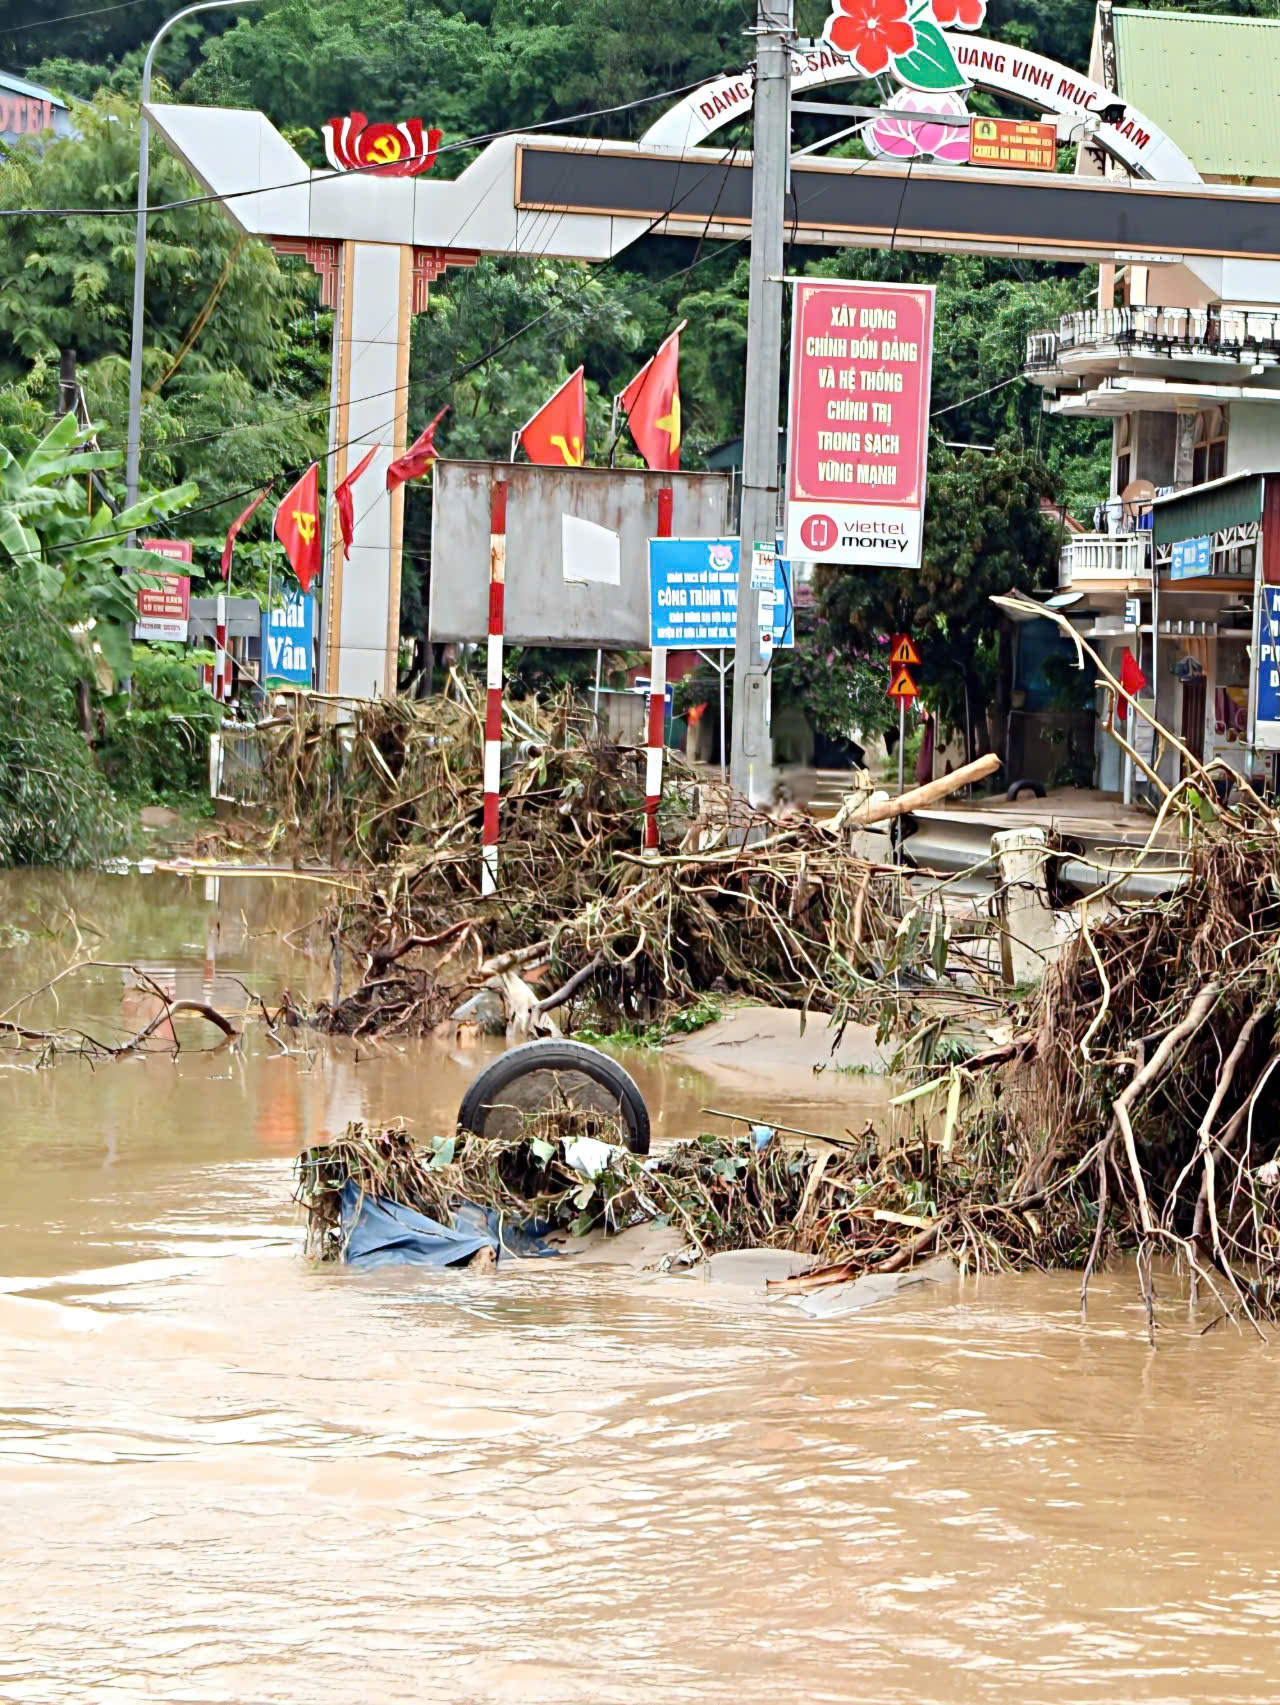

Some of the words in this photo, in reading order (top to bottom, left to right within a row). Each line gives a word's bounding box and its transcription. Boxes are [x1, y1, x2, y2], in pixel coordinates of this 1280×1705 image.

[953, 46, 1005, 73] UANG
[1012, 59, 1053, 90] VINH
[831, 304, 857, 327] XÂY
[860, 308, 897, 332] DỰNG
[818, 364, 835, 388] VÀ
[839, 366, 856, 393] HỆ
[860, 365, 903, 393] THỐNG
[827, 397, 868, 422] CHÍNH
[872, 402, 892, 427] TRỊ
[817, 431, 861, 452] TRONG
[864, 432, 899, 456] SẠCH
[857, 463, 897, 488] MẠNH
[844, 520, 905, 535] viettel
[842, 536, 909, 552] money
[657, 586, 688, 607] CÔNG
[267, 636, 307, 671] Vân
